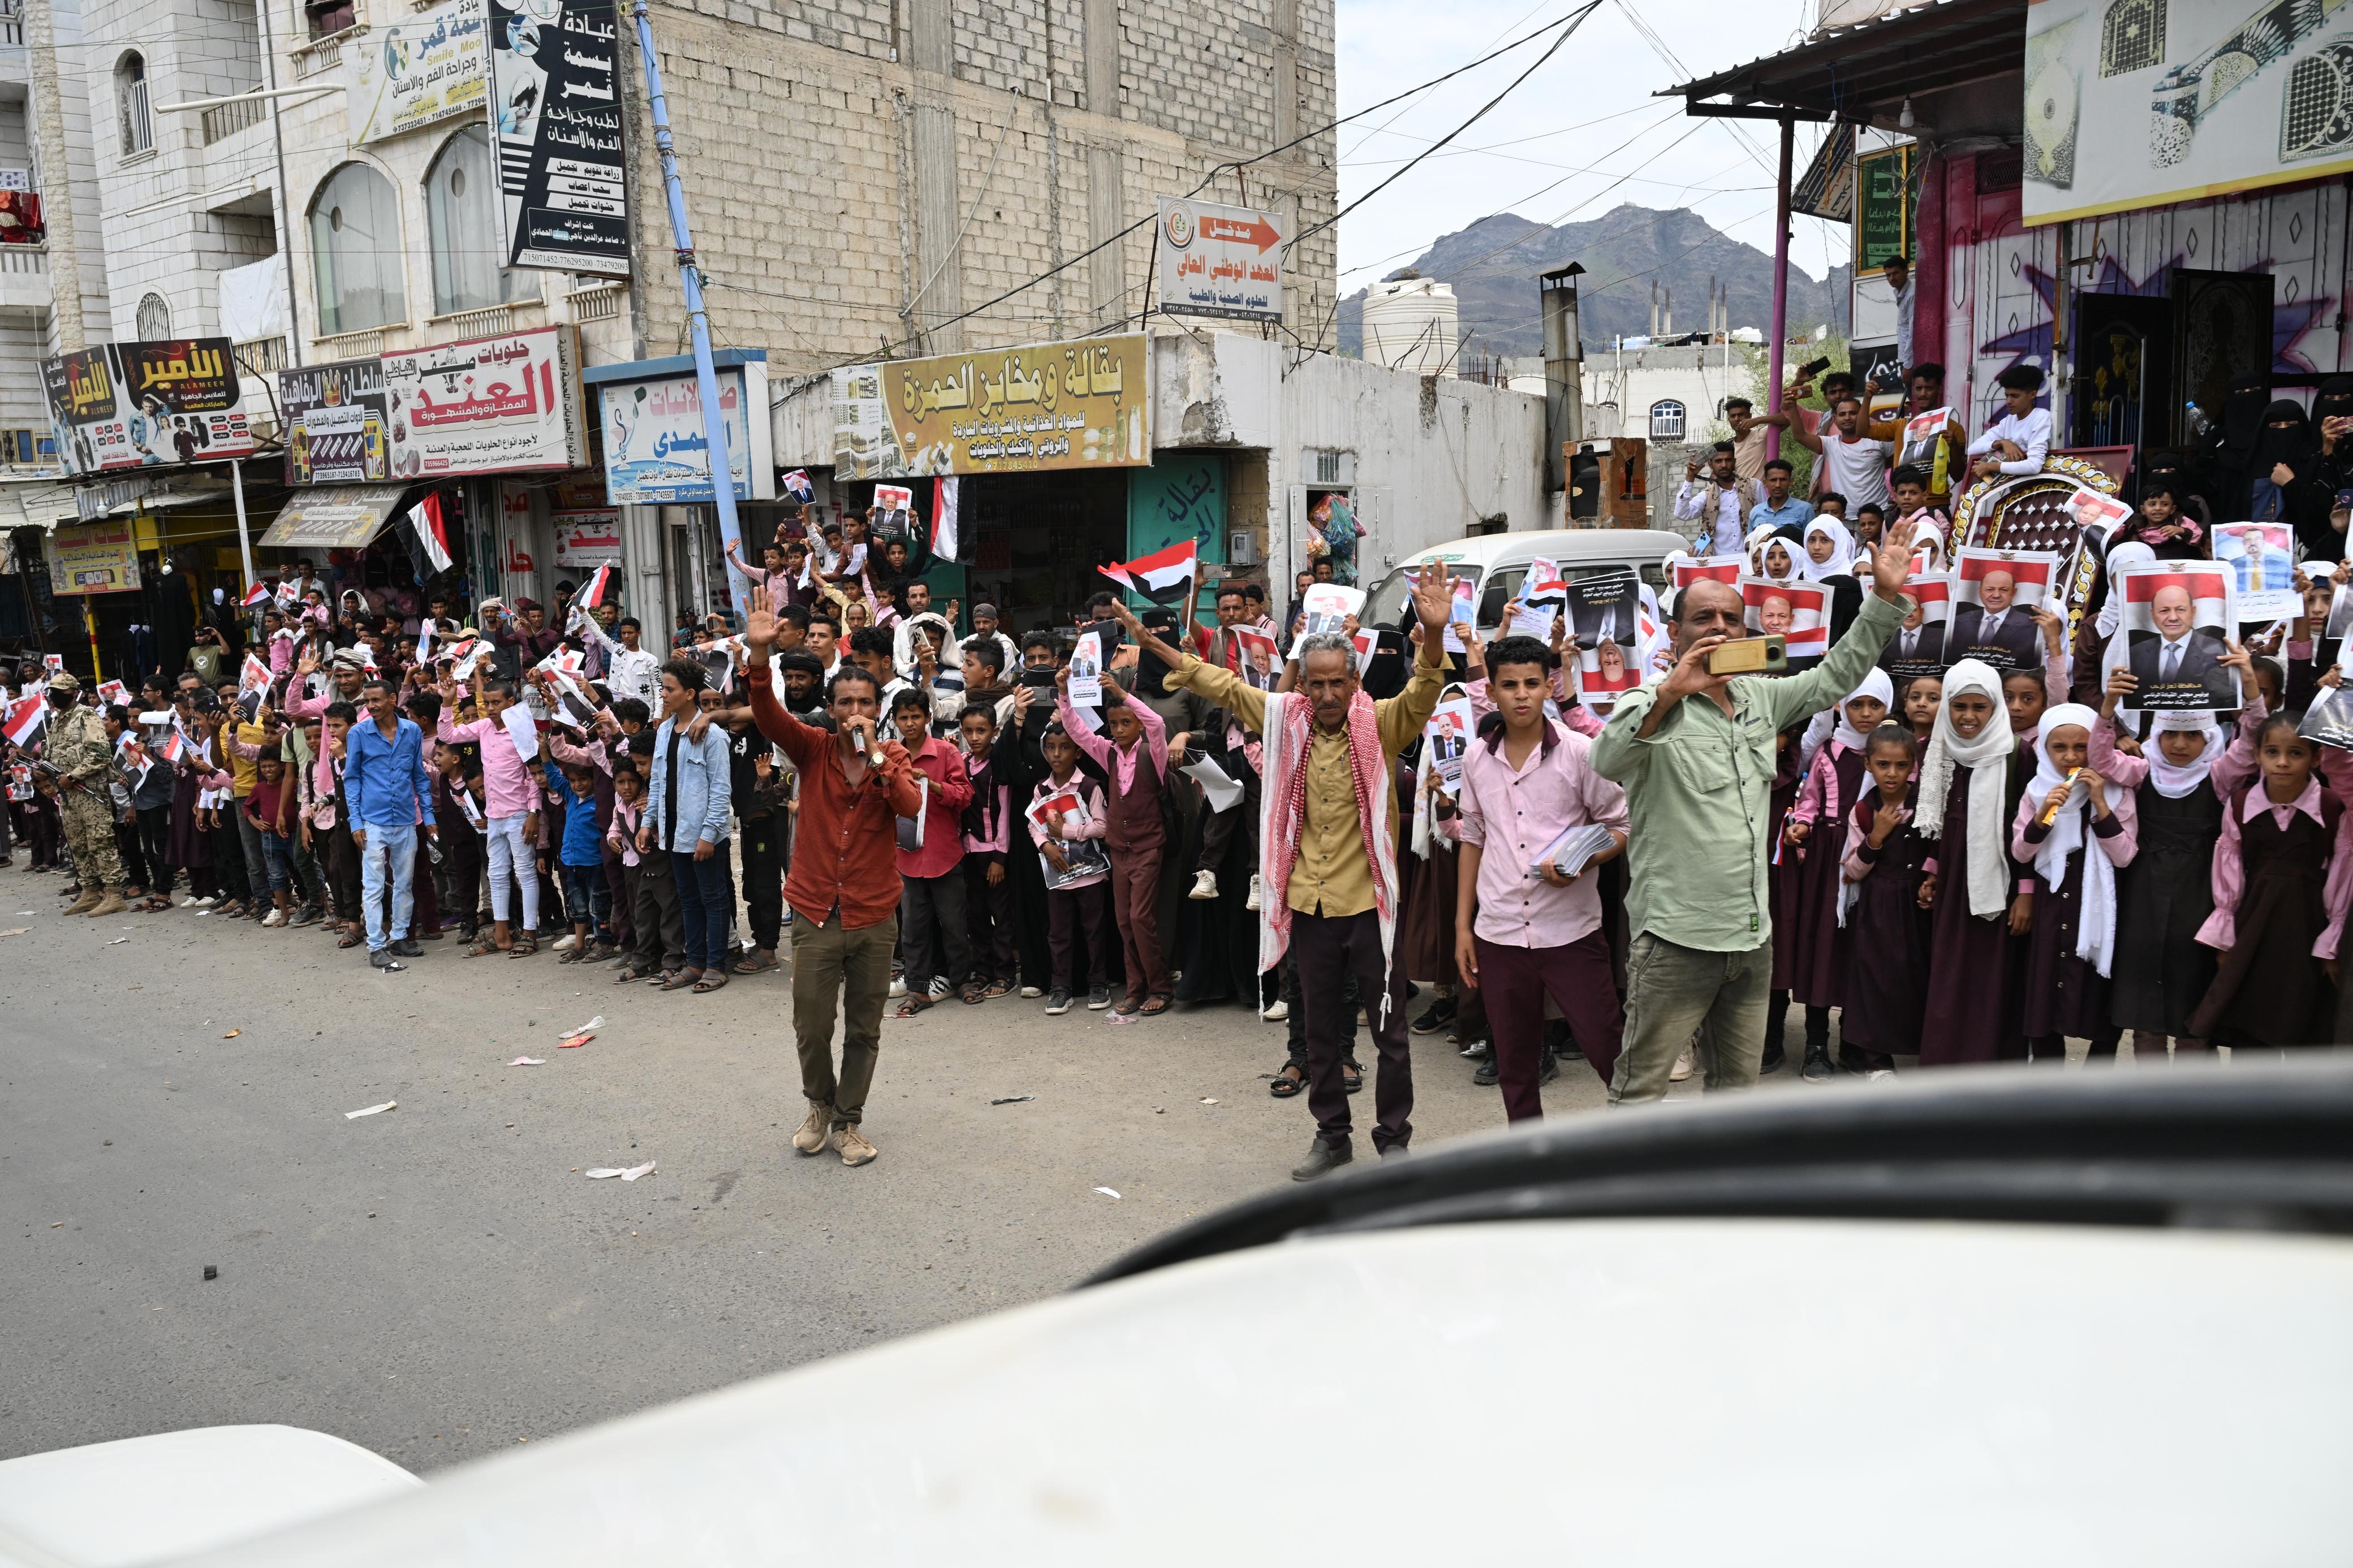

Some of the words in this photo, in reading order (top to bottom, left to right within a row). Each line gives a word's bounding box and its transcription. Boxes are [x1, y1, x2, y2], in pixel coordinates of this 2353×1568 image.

[460, 0, 479, 14] يادة
[564, 11, 615, 43] عيادة
[416, 16, 446, 60] قمر
[427, 49, 454, 66] Smile
[460, 38, 481, 53] Moo
[564, 41, 612, 77] بسمة
[447, 57, 476, 76] وجراحة
[426, 65, 443, 88] الفم
[393, 74, 424, 98] والأسنان
[561, 78, 613, 100] قمر
[398, 117, 426, 132] 737323451
[432, 105, 462, 121] 714745446
[548, 103, 593, 127] وجراحة
[594, 113, 619, 129] لطب
[548, 126, 596, 149] والأسنان
[597, 135, 621, 150] الفم
[557, 161, 578, 174] تجميل
[584, 167, 601, 176] تقويم
[604, 167, 619, 180] زراعة
[568, 180, 590, 192] اعصاب
[592, 184, 610, 195] سحب
[568, 198, 589, 210] تجميل
[591, 201, 614, 213] حشوات
[531, 227, 552, 238] الحمادي
[564, 219, 581, 231] إشراف
[1209, 219, 1251, 240] مدخل
[569, 232, 582, 242] ناجي
[605, 236, 618, 244] صامد
[1177, 253, 1206, 282] العالي
[1209, 257, 1247, 285] الوطني
[1249, 262, 1278, 283] المعهد
[1189, 287, 1216, 305] والطبية
[1219, 290, 1243, 306] الصحية
[1246, 294, 1268, 309] للعلوم
[478, 339, 529, 366] حلويات
[47, 359, 63, 373] للملابس
[140, 342, 223, 390] الأمير
[416, 353, 476, 384] صقر
[1065, 345, 1123, 405] بقالة
[49, 375, 66, 389] الجاهزة
[70, 353, 110, 416] الأمير
[181, 381, 225, 389] ALAMEER
[343, 366, 385, 405] سلطان
[979, 356, 1058, 418] ومخابز
[181, 392, 202, 401] الجاهزة
[203, 391, 226, 399] للملابس
[281, 373, 322, 412] الرفاهية
[410, 358, 555, 427] العند
[903, 360, 975, 423] الحمزة
[91, 405, 113, 415] ALAMEER
[484, 398, 527, 413] الممتازة
[650, 381, 737, 422] صلانيات
[306, 414, 329, 429] والعطورات
[330, 412, 350, 427] التجميل
[350, 408, 363, 425] لأدوات
[421, 405, 484, 421] والمشهورة
[1058, 411, 1085, 432] للمواد
[953, 420, 979, 439] الباردة
[980, 416, 1021, 439] والمشروبات
[1023, 414, 1057, 435] الغذائية
[426, 444, 451, 454] والعدنية
[451, 443, 474, 453] اللحجية
[476, 439, 502, 452] الحلويات
[502, 435, 518, 450] أنواع
[519, 433, 537, 448] لأجود
[969, 440, 1005, 458] والحلويات
[1007, 437, 1034, 457] والكيك
[1037, 435, 1070, 458] والروتي
[993, 460, 1038, 470] 717845410
[656, 490, 675, 499] 774355017
[1158, 467, 1216, 522] بقالة
